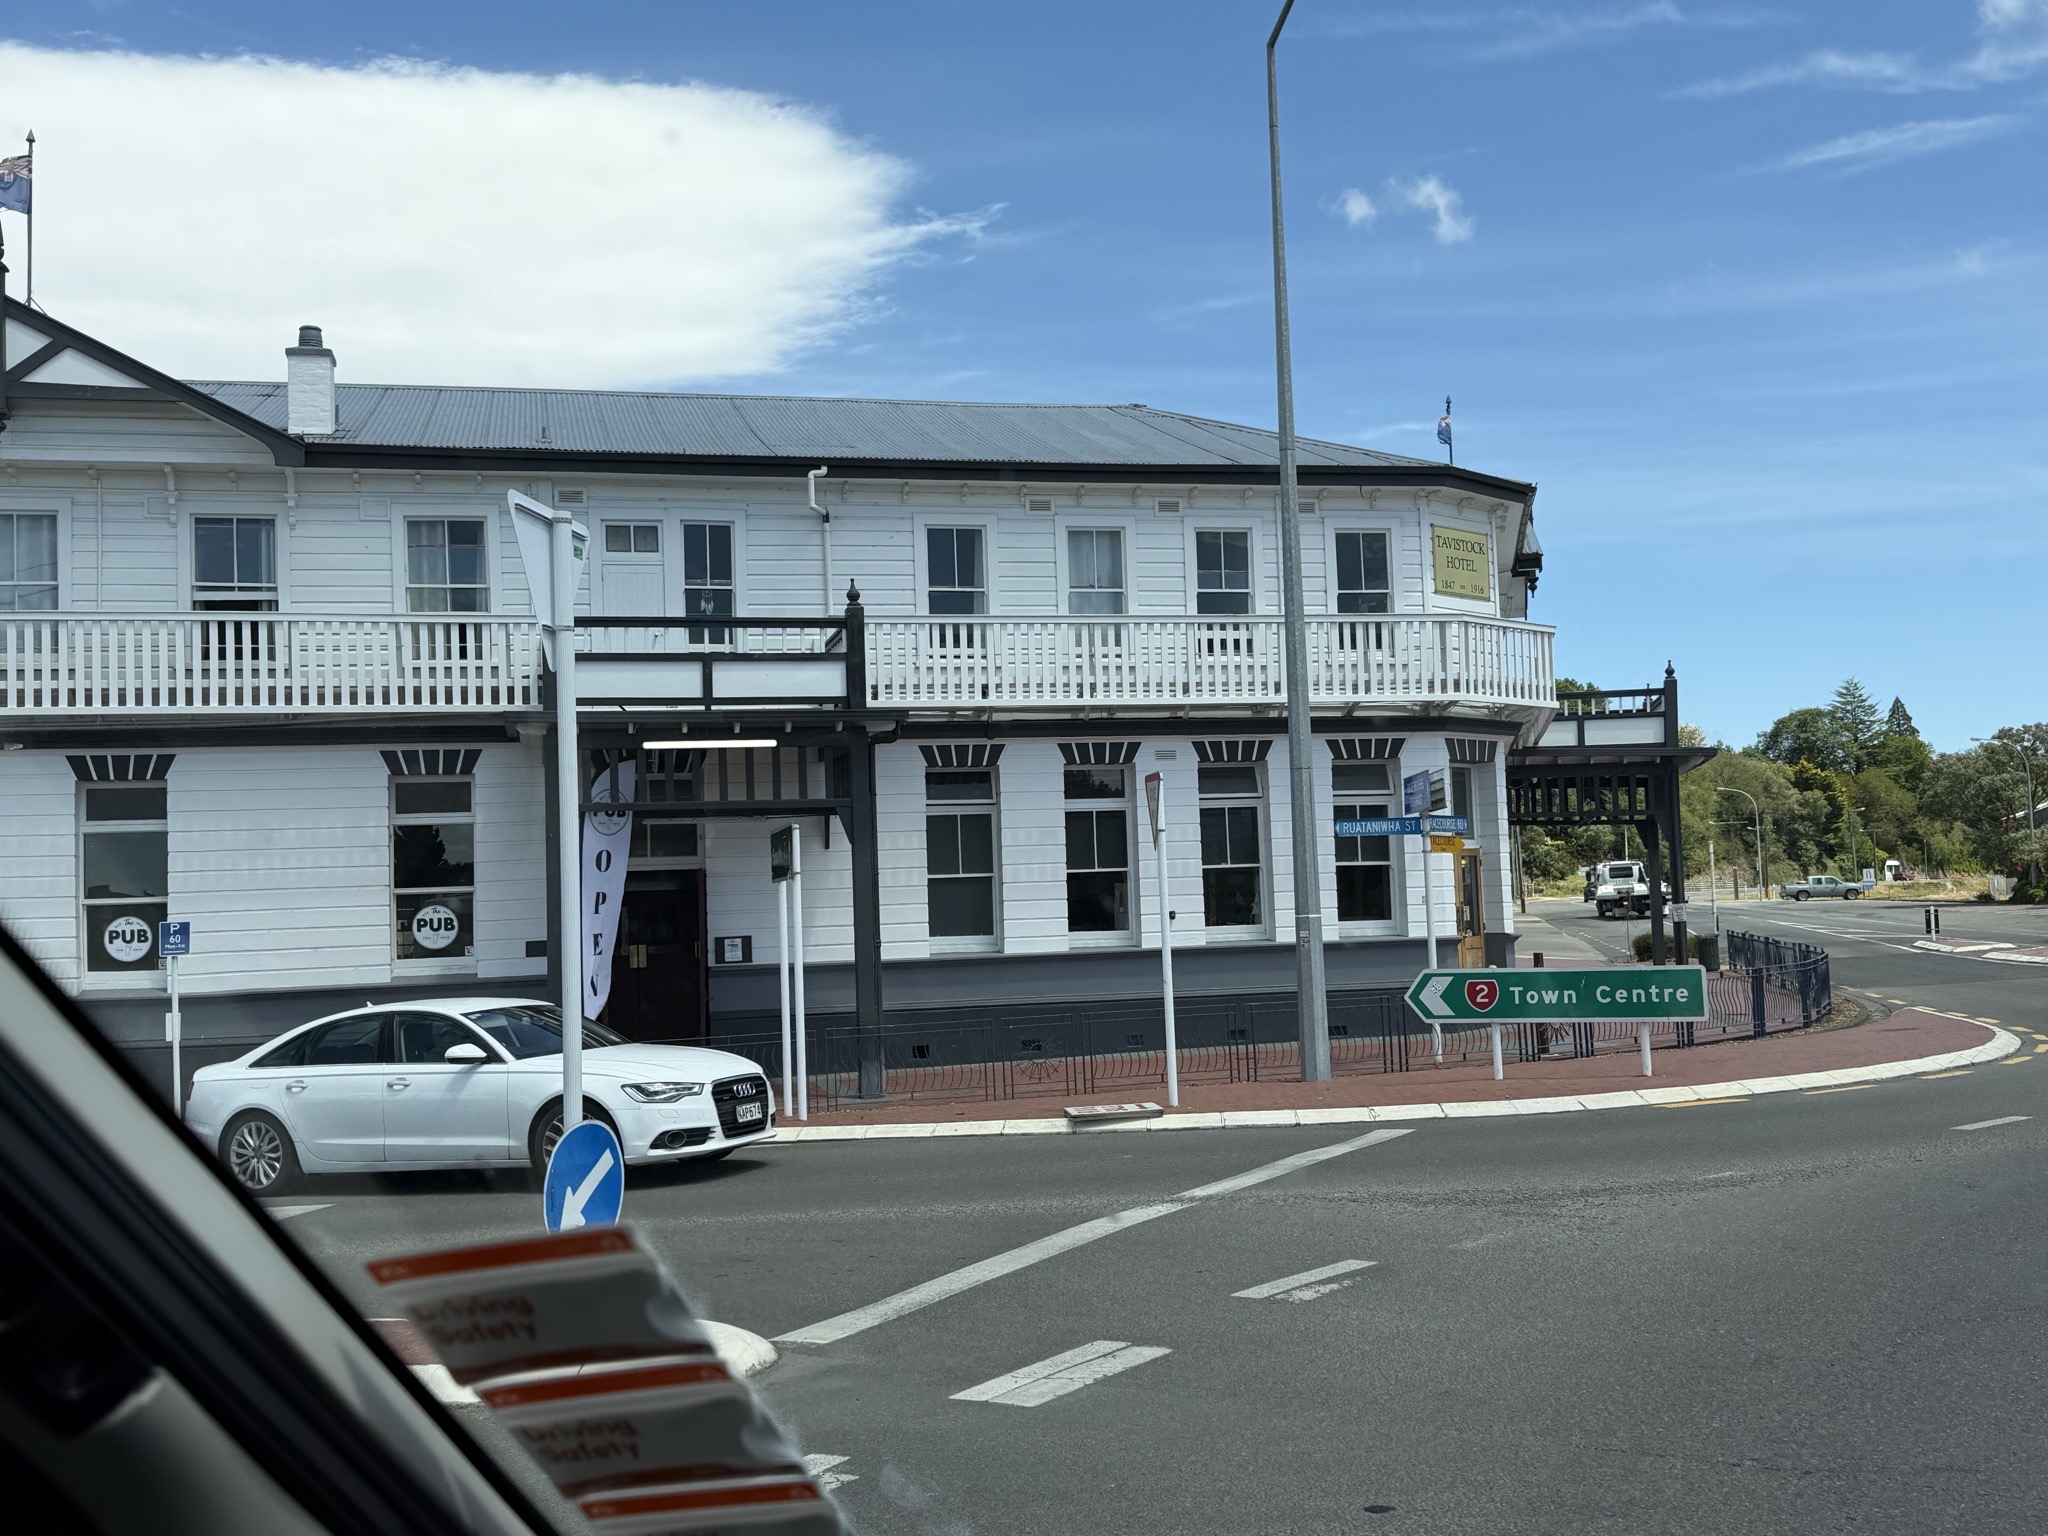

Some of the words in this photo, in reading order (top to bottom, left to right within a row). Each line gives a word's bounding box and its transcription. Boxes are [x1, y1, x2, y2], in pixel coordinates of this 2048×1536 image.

[1435, 534, 1486, 555] TAVISTOCK
[1446, 555, 1477, 572] HOTEL
[1441, 579, 1455, 590] 1847
[1470, 584, 1484, 594] 1916
[1343, 820, 1401, 833] RUATANIWHA
[1404, 820, 1416, 831] ST
[170, 923, 180, 933] P
[416, 917, 456, 932] PUB
[590, 849, 612, 997] OPEN
[108, 928, 149, 944] PUB
[169, 934, 181, 943] 60
[1475, 985, 1489, 1003] 2
[1509, 986, 1577, 1004] Town
[1596, 984, 1689, 1003] Centre
